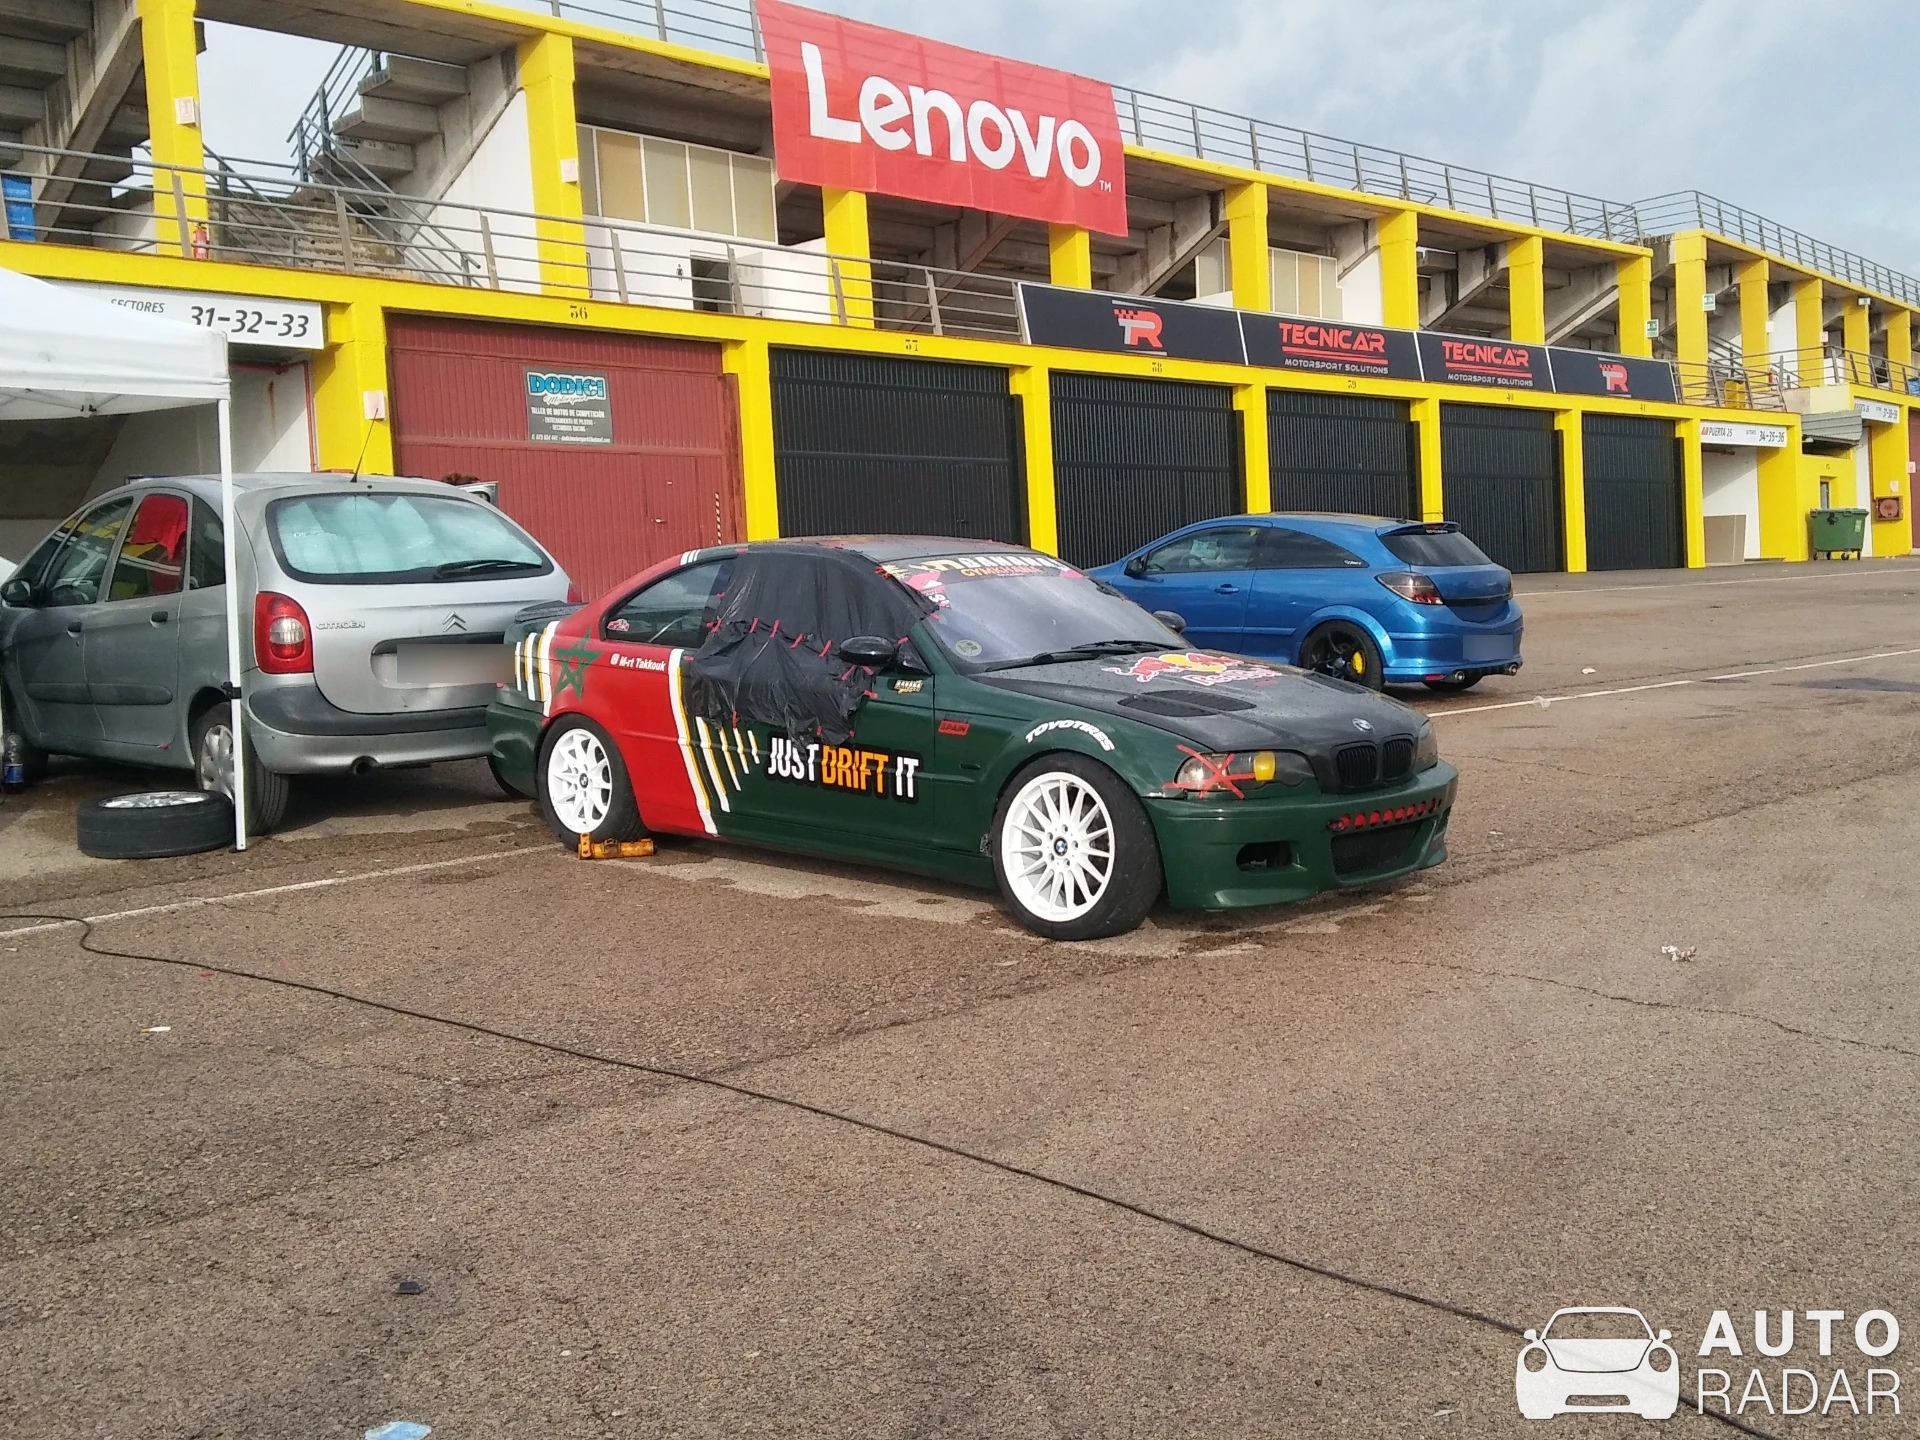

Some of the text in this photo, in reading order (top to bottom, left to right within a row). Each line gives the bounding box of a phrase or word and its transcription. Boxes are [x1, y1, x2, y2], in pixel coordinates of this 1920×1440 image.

[801, 41, 1101, 187] Lenovo
[570, 305, 588, 319] 36
[1278, 322, 1385, 353] TECNICAR
[1441, 340, 1530, 368] TECNICAR
[1284, 358, 1389, 375] MOTORSPORT SOLUTIONS
[528, 373, 606, 399] DODICI
[1447, 373, 1534, 387] MOTORSPORT SOLUTIONS
[1708, 426, 1726, 437] PUERTA
[1759, 430, 1785, 443] 34-35-36
[635, 657, 667, 672] Takkouk
[768, 737, 919, 798] JUST DRIFT IT
